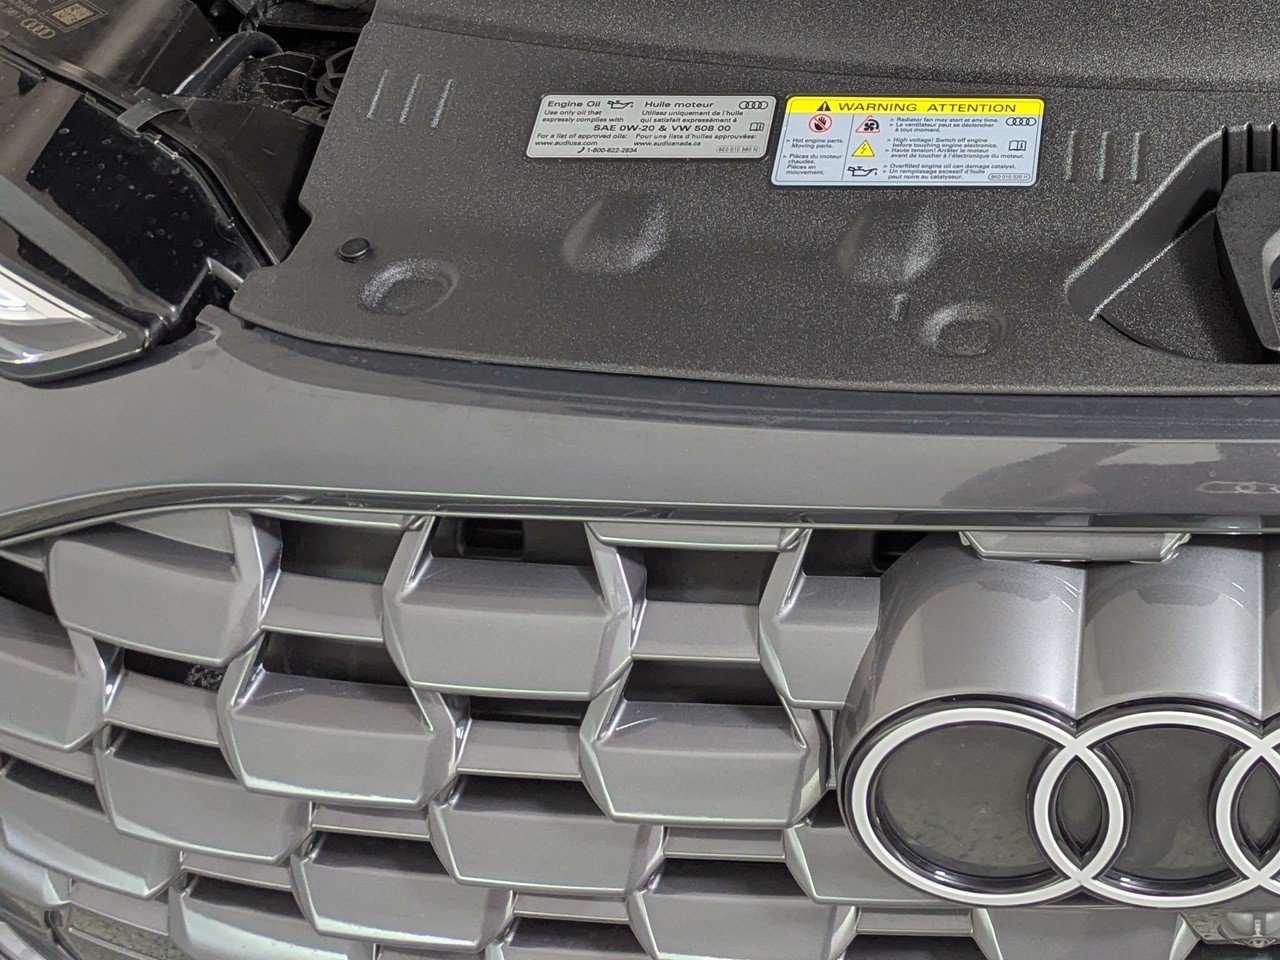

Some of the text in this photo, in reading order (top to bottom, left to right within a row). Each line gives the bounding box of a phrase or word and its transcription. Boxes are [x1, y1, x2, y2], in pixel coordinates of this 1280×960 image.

[547, 100, 583, 108] Engine
[838, 103, 1016, 112] WARNING ATTENTION
